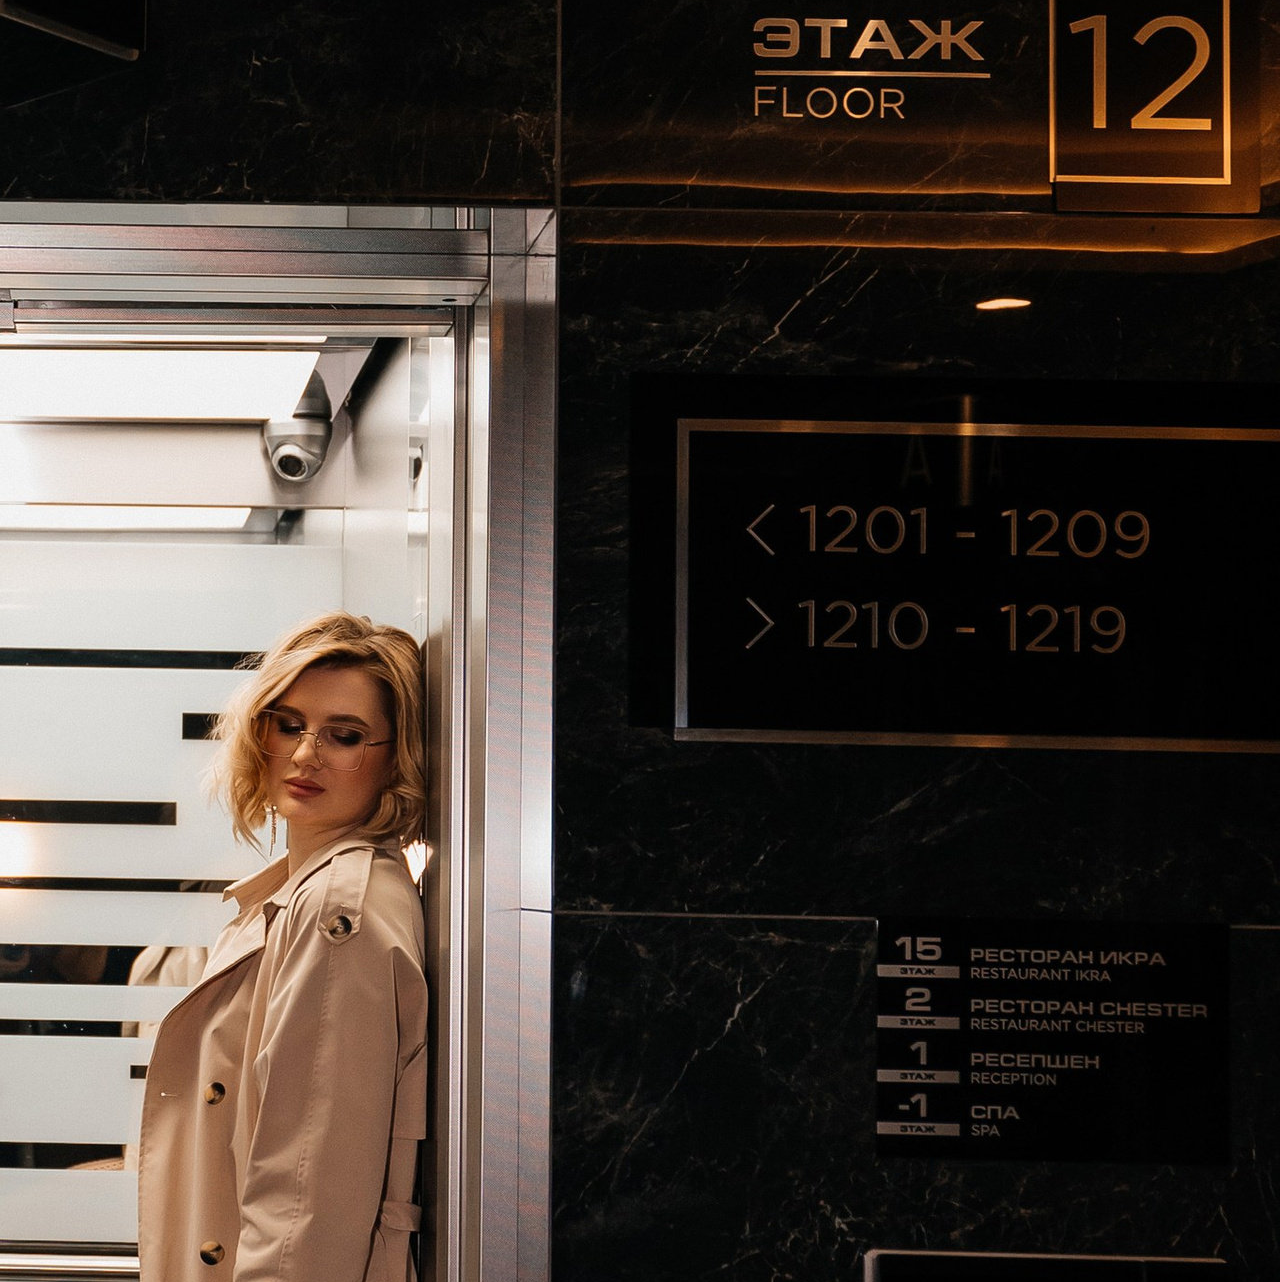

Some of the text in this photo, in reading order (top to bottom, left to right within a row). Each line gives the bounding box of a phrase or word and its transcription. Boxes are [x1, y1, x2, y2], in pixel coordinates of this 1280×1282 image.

[754, 18, 984, 60] ЭТАЖ
[1070, 16, 1212, 130] 12
[755, 87, 904, 119] FLOOR
[800, 505, 926, 553] 1201
[1001, 509, 1149, 558] 1209
[799, 600, 928, 649] 1210
[1000, 604, 1125, 653] 1219
[895, 936, 942, 961] 15
[970, 948, 1166, 966] РЕСТОРАН ИКРА
[899, 966, 936, 976] ЭТАЖ
[970, 966, 1112, 982] RESTAURANT IKRA
[905, 987, 932, 1012] 2
[970, 998, 1207, 1018] РЕСТОРАН CHESTER
[899, 1018, 936, 1027] ЭТАЖ
[970, 1017, 1145, 1034] RESTAURANT CHESTER
[909, 1041, 928, 1066] 1
[970, 1052, 1100, 1069] РЕСЕПШЕН
[899, 1072, 936, 1081] ЭТАЖ
[970, 1071, 1057, 1086] RECEPTION
[898, 1093, 927, 1118] -1
[970, 1105, 1020, 1120] СПА
[899, 1124, 936, 1134] ЭТАЖ
[970, 1124, 1001, 1137] SPA
